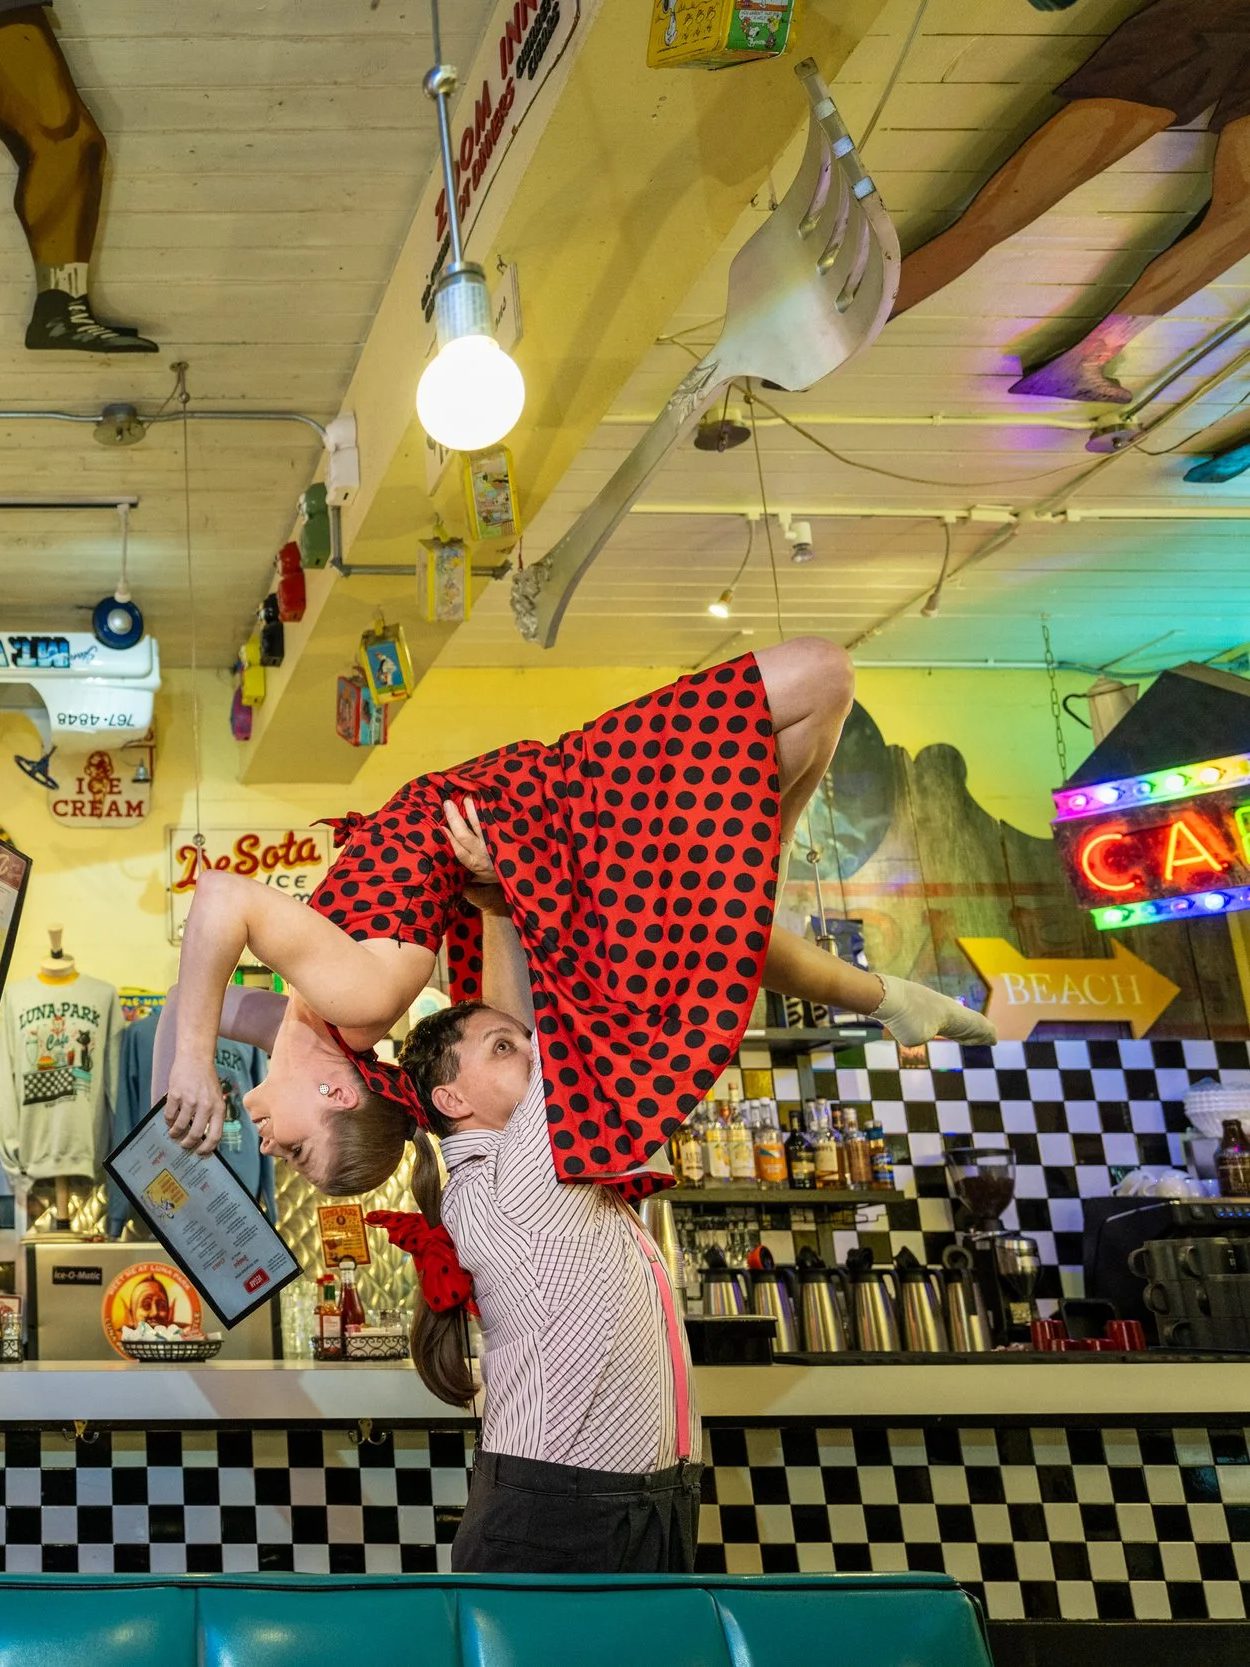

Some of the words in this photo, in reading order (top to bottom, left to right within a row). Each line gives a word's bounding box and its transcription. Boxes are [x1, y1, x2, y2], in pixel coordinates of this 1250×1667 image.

[435, 80, 492, 242] ZOM
[75, 777, 122, 795] ICE
[52, 799, 145, 818] CREAM
[266, 873, 308, 889] ICE
[1000, 972, 1144, 1006] BEACH
[19, 1003, 56, 1029] LUNA
[61, 1002, 101, 1028] PARK
[53, 1270, 102, 1281] Ice-O-Matic
[150, 1264, 172, 1275] LUNA
